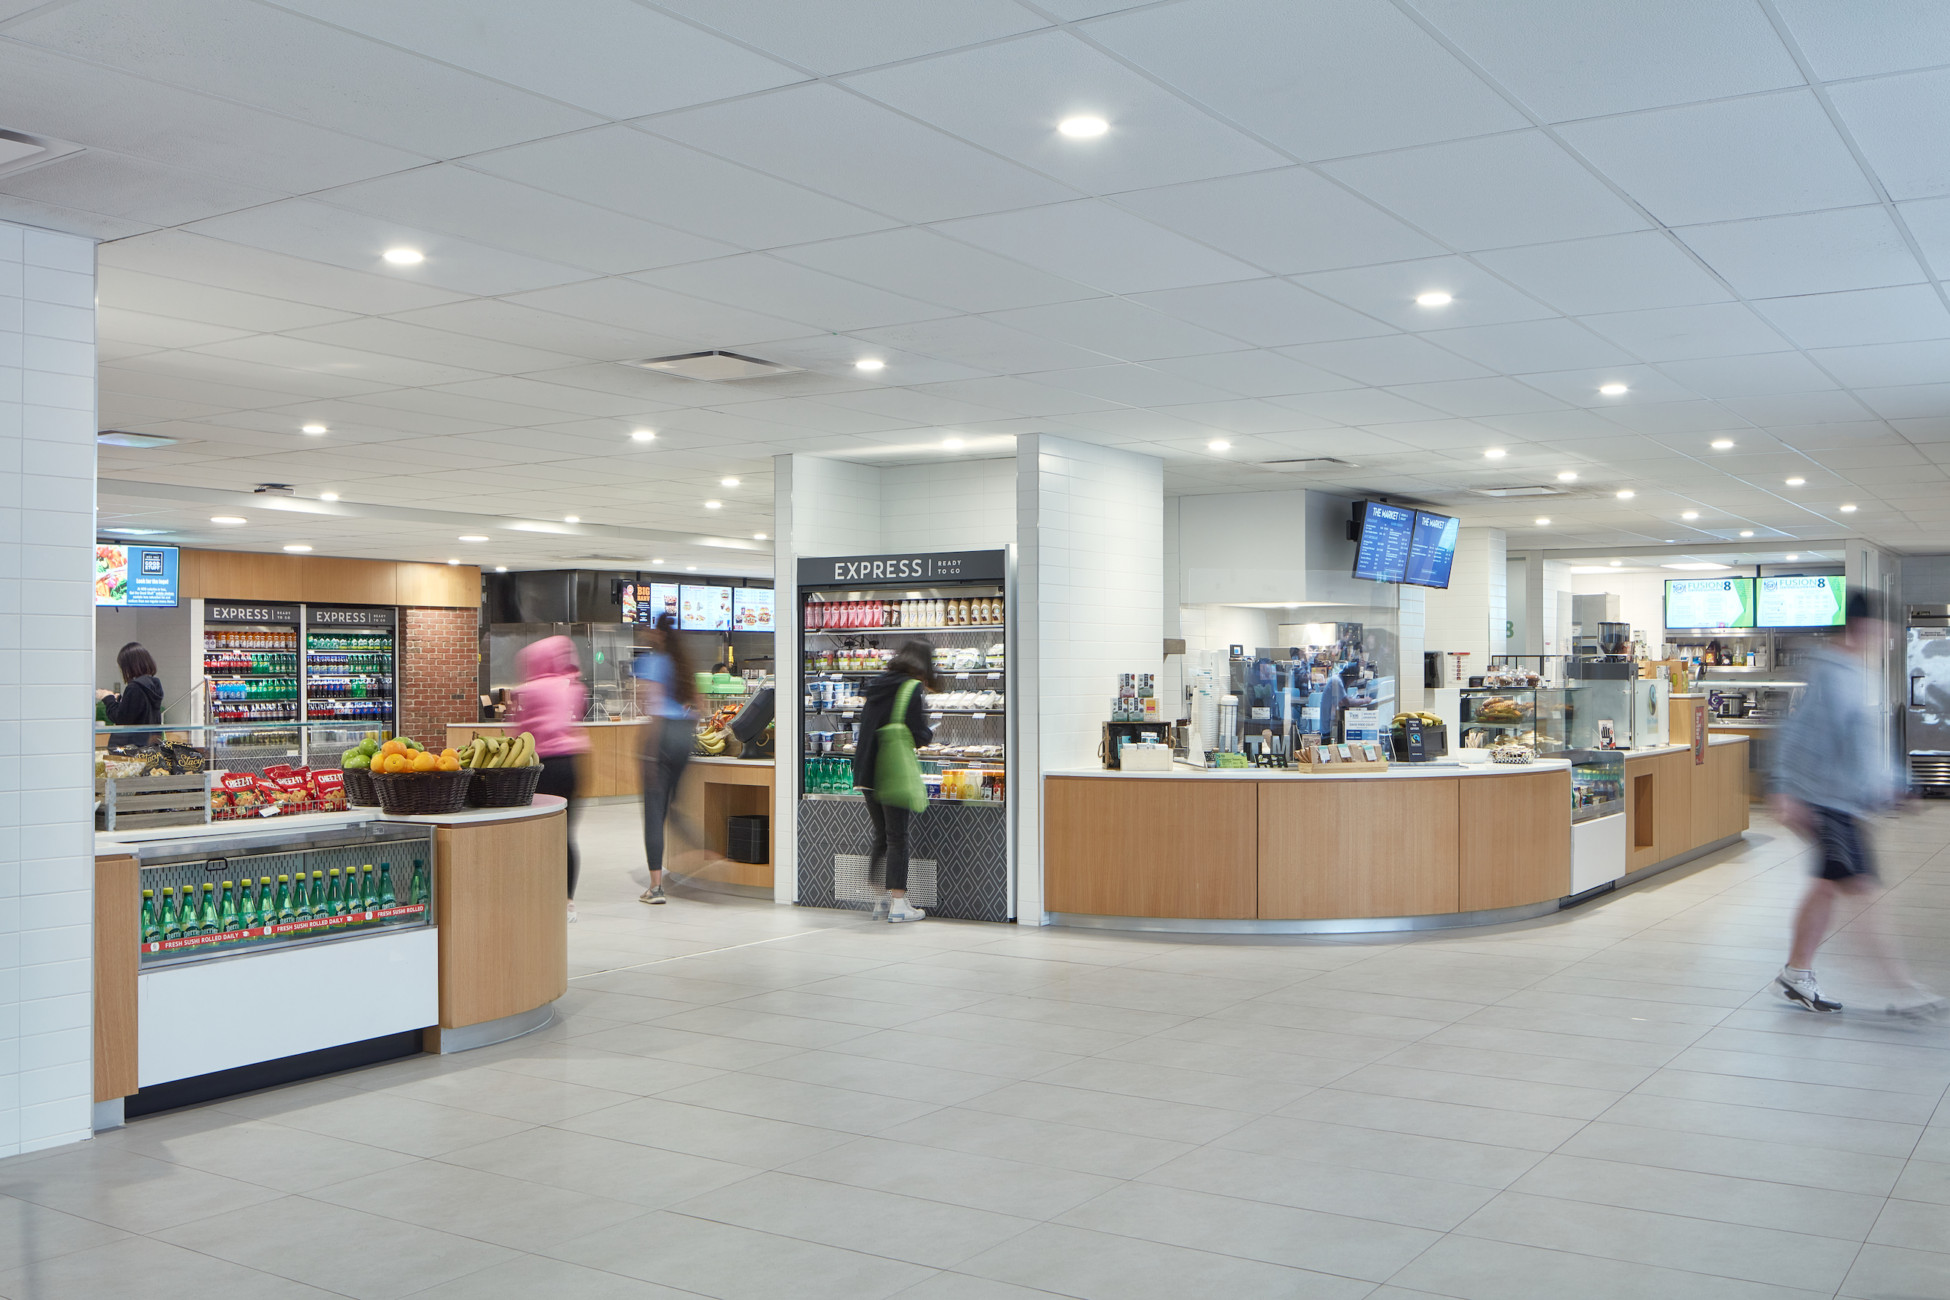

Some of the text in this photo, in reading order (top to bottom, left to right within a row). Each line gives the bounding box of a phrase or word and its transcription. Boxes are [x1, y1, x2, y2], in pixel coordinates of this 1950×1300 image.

[1373, 507, 1382, 517] THE
[1382, 509, 1399, 520] MARKET
[1422, 517, 1444, 529] THE MARKET
[834, 559, 922, 580] EXPRESS
[637, 586, 650, 595] BIG
[214, 608, 268, 620] EXPRESS
[316, 612, 366, 623] EXPRESS
[225, 776, 254, 788] CHEEZ-IT
